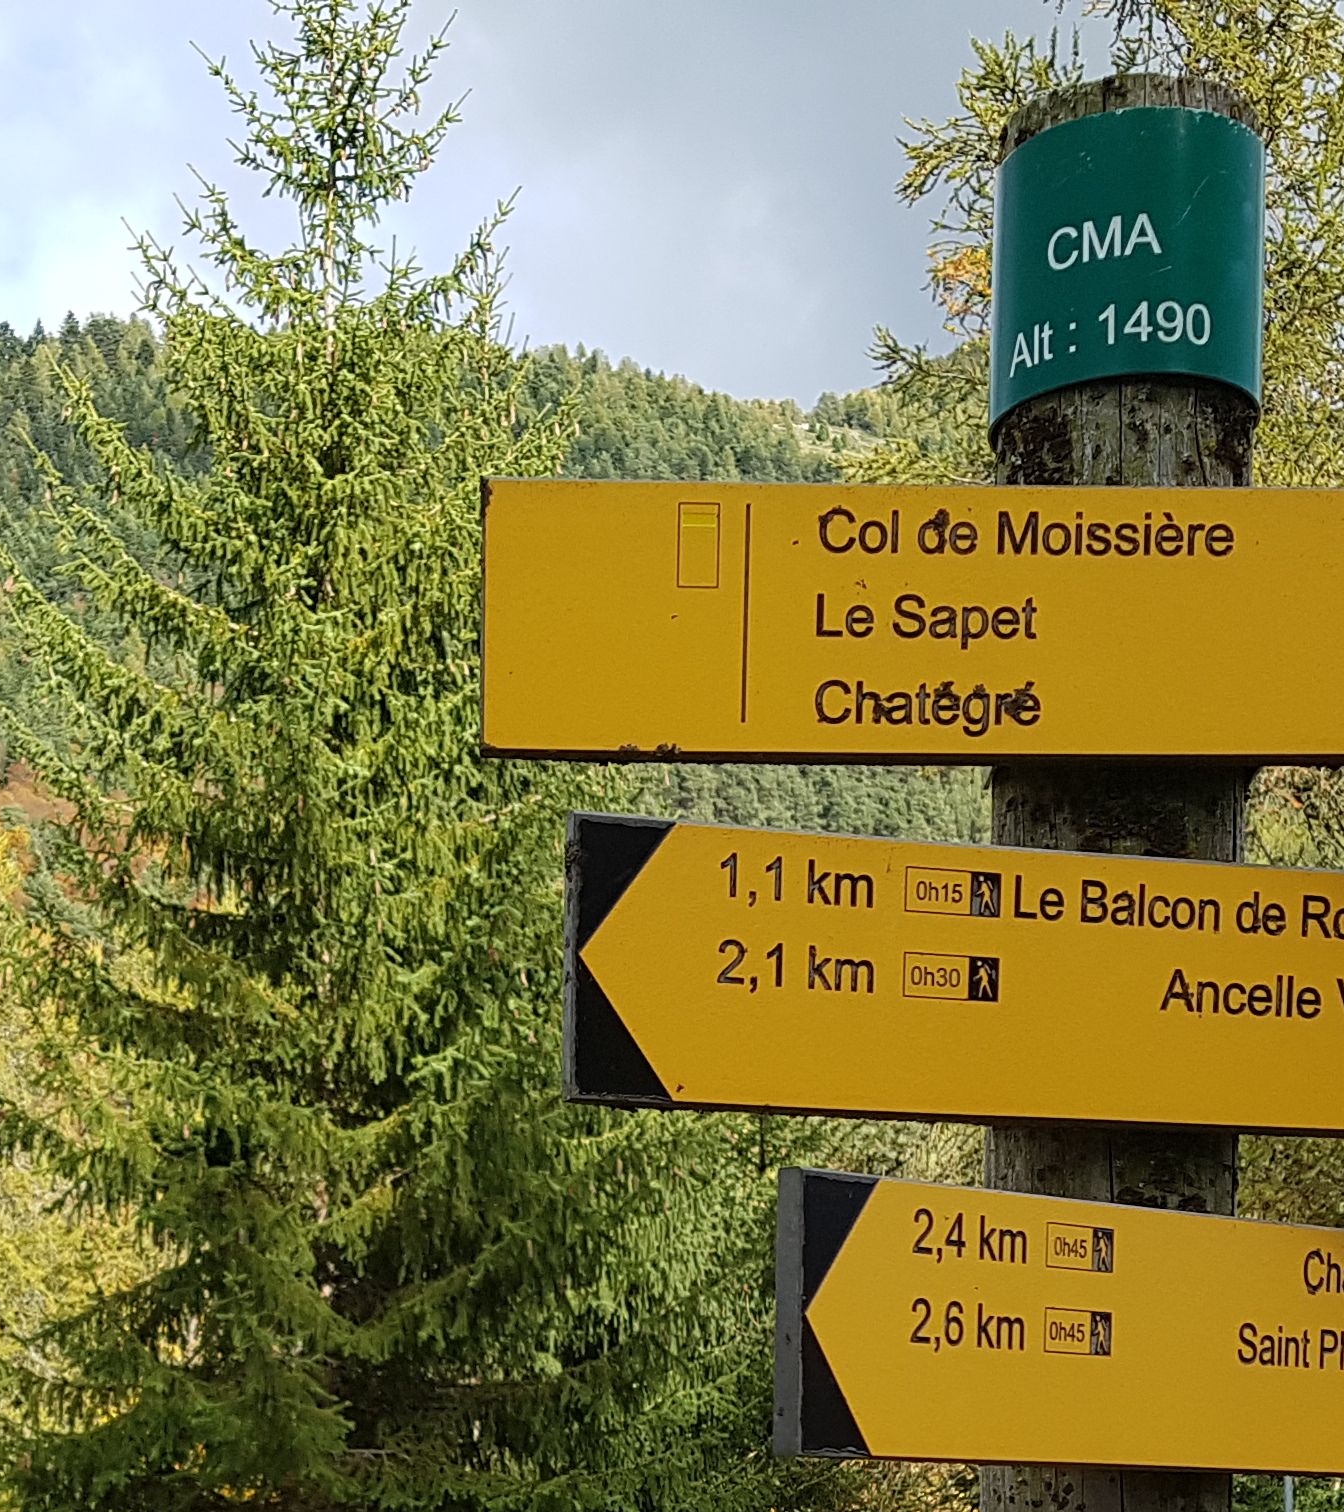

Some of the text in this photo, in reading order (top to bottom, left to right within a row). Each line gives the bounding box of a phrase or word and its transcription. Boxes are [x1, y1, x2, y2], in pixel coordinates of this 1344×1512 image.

[1047, 212, 1162, 271] CMA
[1009, 321, 1054, 379] Alt
[1097, 300, 1211, 346] 1490
[818, 507, 1234, 556] Col de Moissière
[815, 593, 1037, 650] Le Sapet
[815, 680, 1041, 737] Chatégré
[719, 852, 874, 909] 1,1 km
[915, 879, 963, 904] 0h15
[1013, 875, 1065, 921] Le
[1080, 879, 1220, 933] Balcon
[1236, 891, 1286, 936] de
[716, 938, 875, 994] 2,1 km
[910, 965, 961, 989] 0h30
[1160, 968, 1321, 1019] Ancelle
[912, 1208, 1027, 1264] 2,4 km
[1054, 1236, 1088, 1259] 0h45
[910, 1298, 1025, 1352] 2,6 km
[1049, 1320, 1086, 1343] 0h45
[1238, 1322, 1310, 1368] Saint
